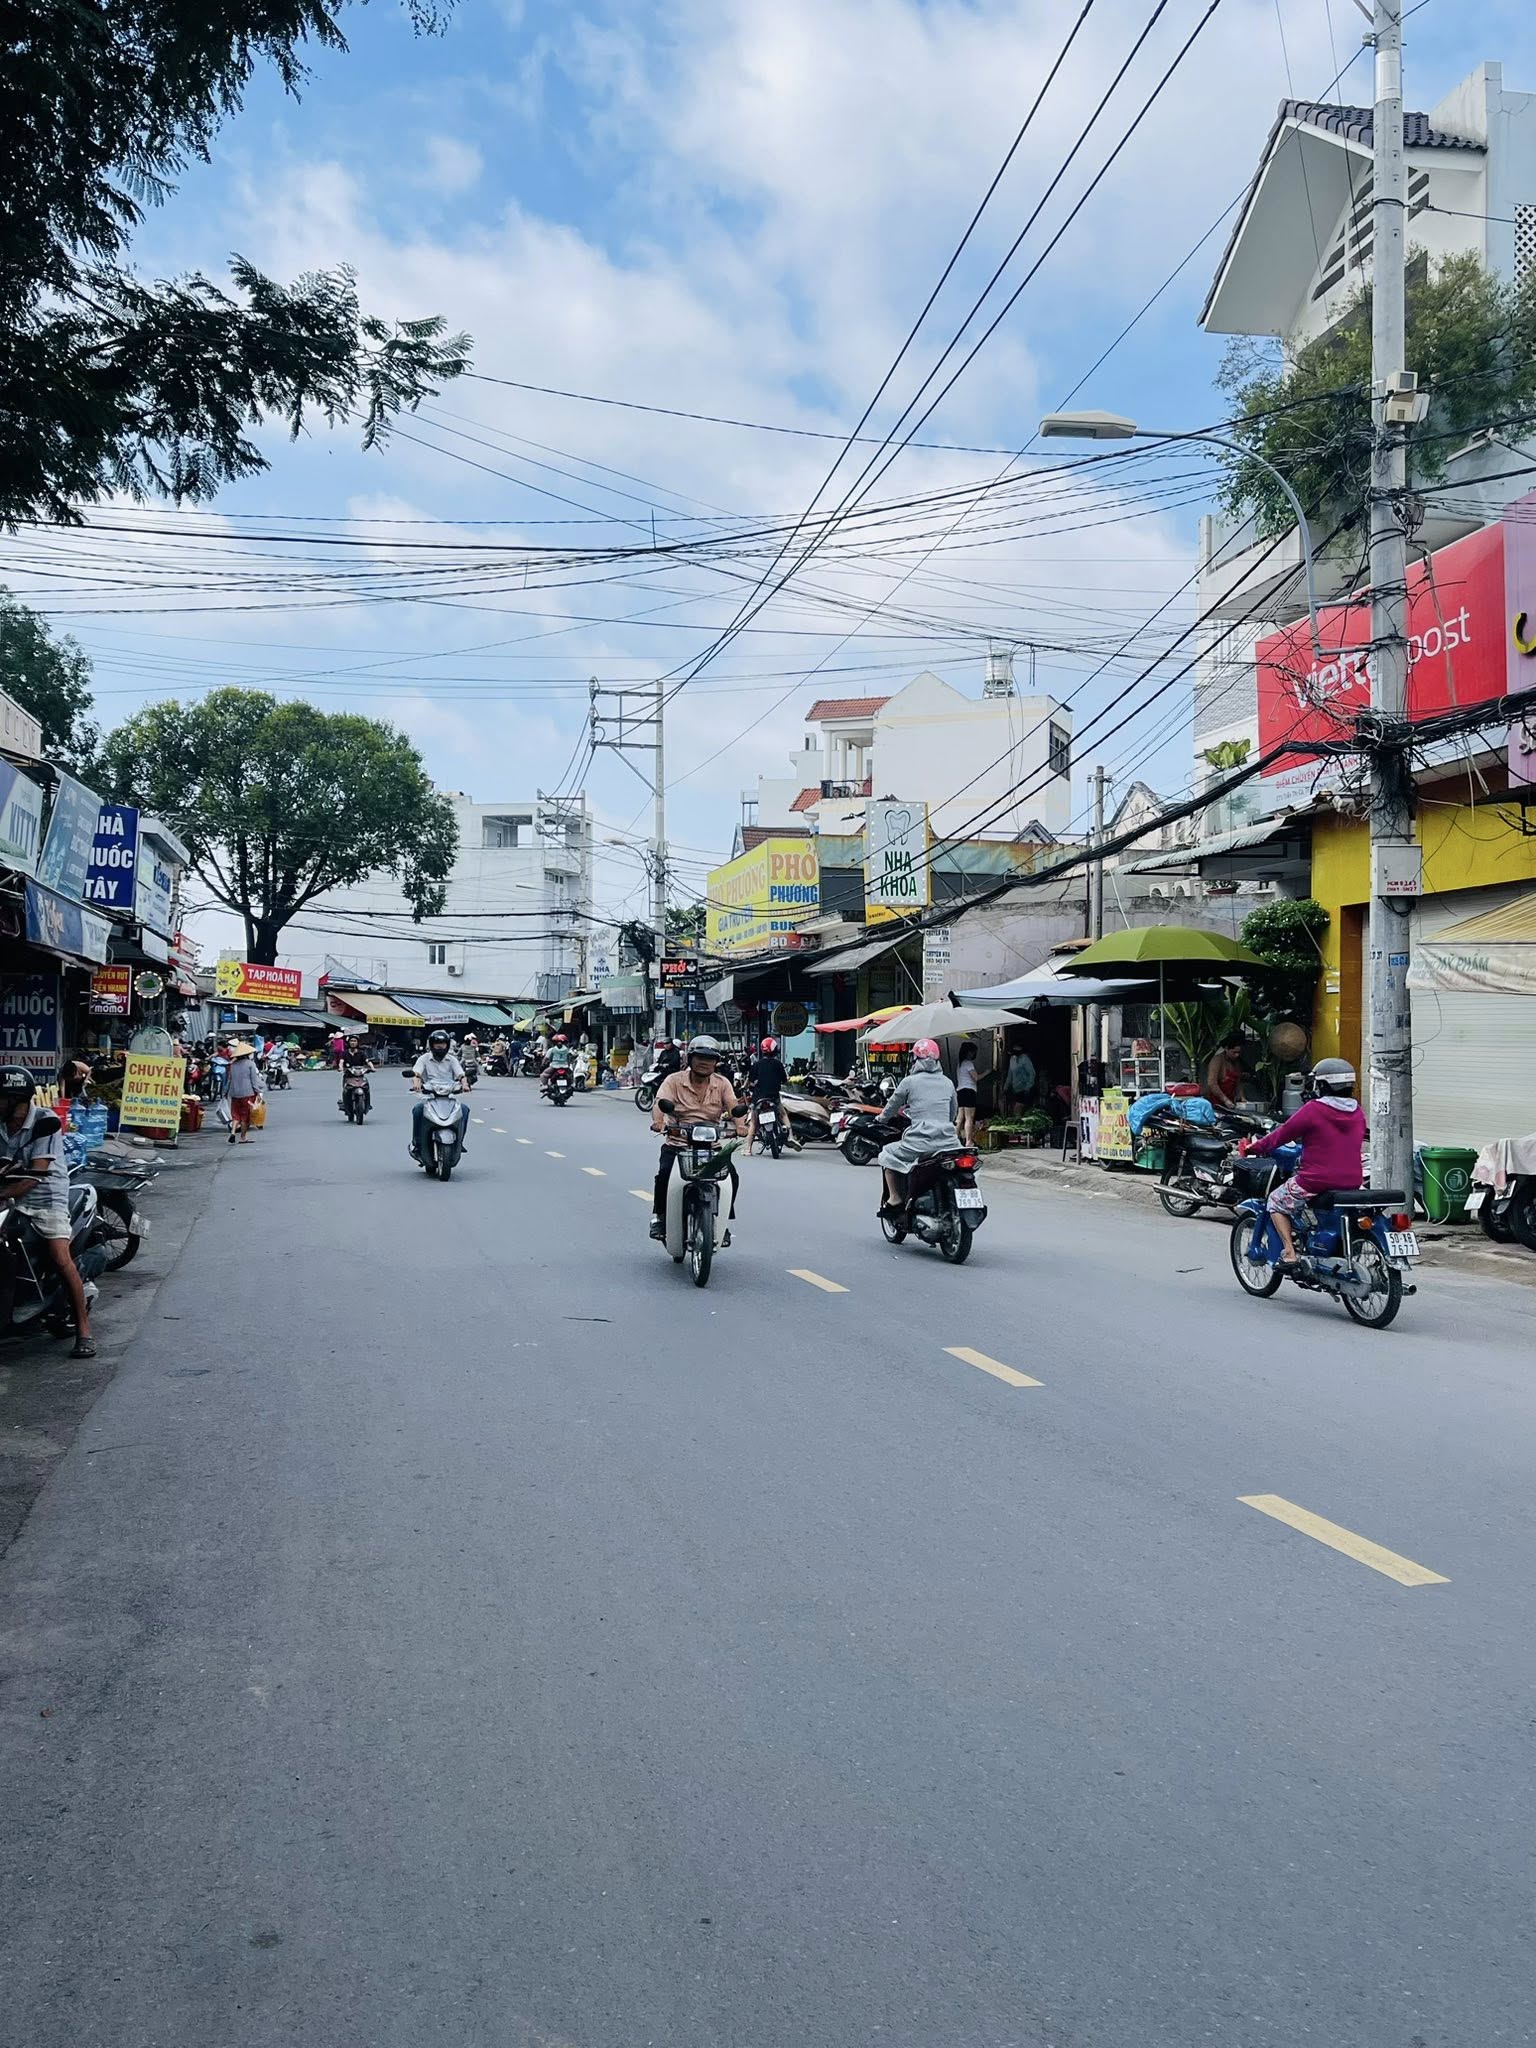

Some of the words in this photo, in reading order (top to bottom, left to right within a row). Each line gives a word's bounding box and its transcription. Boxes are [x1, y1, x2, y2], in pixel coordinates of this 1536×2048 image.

[1407, 605, 1471, 674] post
[96, 812, 124, 836] HÀ
[770, 842, 817, 881] PHỞ
[885, 850, 912, 871] NHA
[84, 875, 119, 900] TÂY
[880, 875, 917, 896] KHOA
[662, 959, 687, 973] PHỞ
[2, 1023, 42, 1048] TÂY
[129, 1061, 182, 1079] CHUYỂN
[128, 1079, 150, 1094] RÚT
